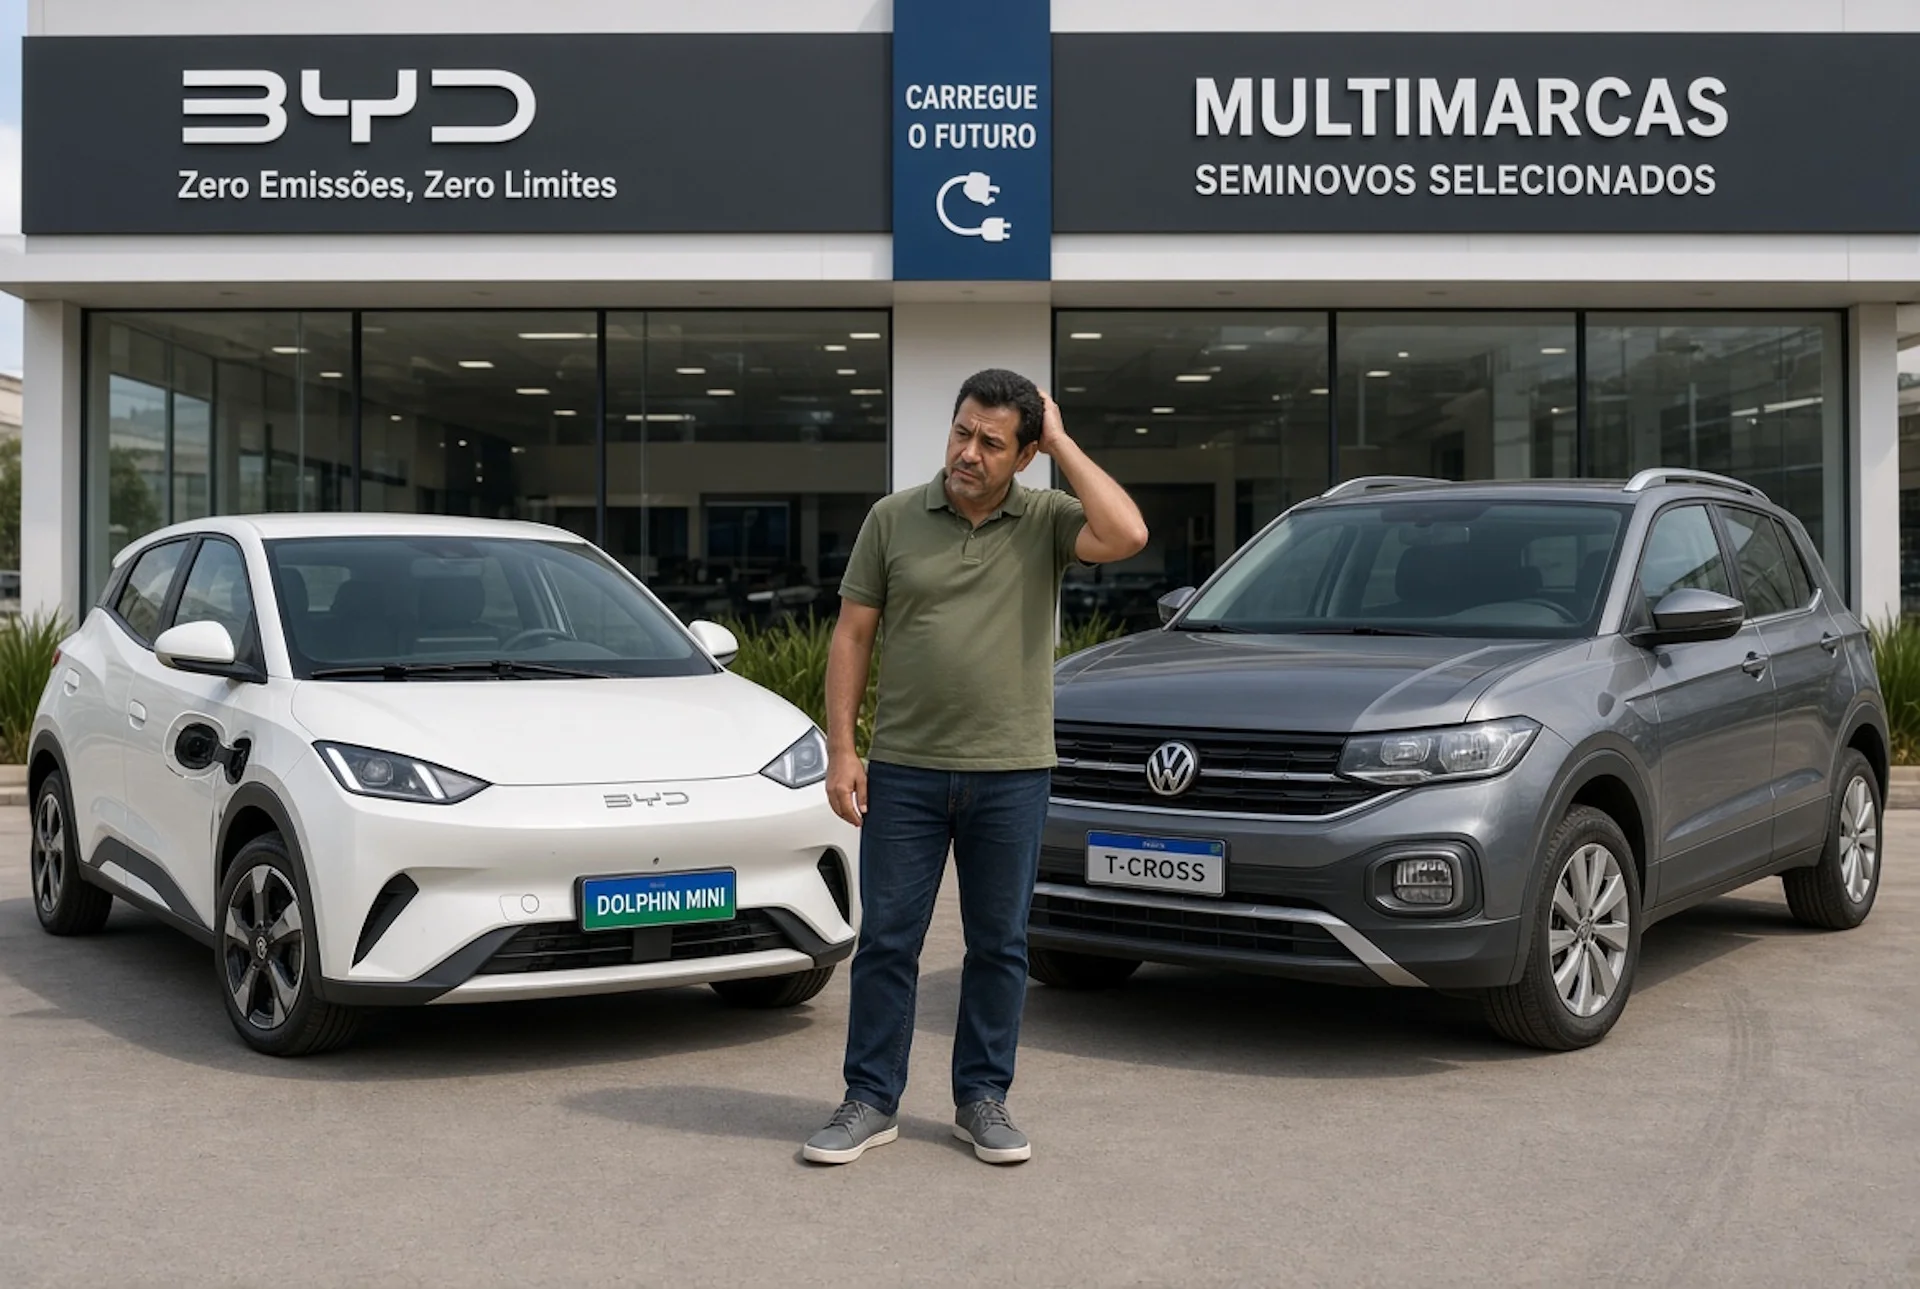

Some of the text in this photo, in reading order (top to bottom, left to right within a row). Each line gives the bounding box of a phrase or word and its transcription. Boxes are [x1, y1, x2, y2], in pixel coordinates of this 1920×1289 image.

[183, 70, 536, 143] BYD
[905, 84, 1038, 110] CARREGUE
[1195, 77, 1728, 137] MULTIMARCAS
[908, 123, 1037, 149] O FUTURO
[178, 169, 618, 203] Zero Emissões, Zero Limites
[1195, 163, 1716, 195] SEMINOVOS SELECIONADOS
[603, 791, 690, 809] BYD
[1104, 855, 1206, 883] T-CROSS
[597, 887, 725, 916] DOLPHIN MINI
